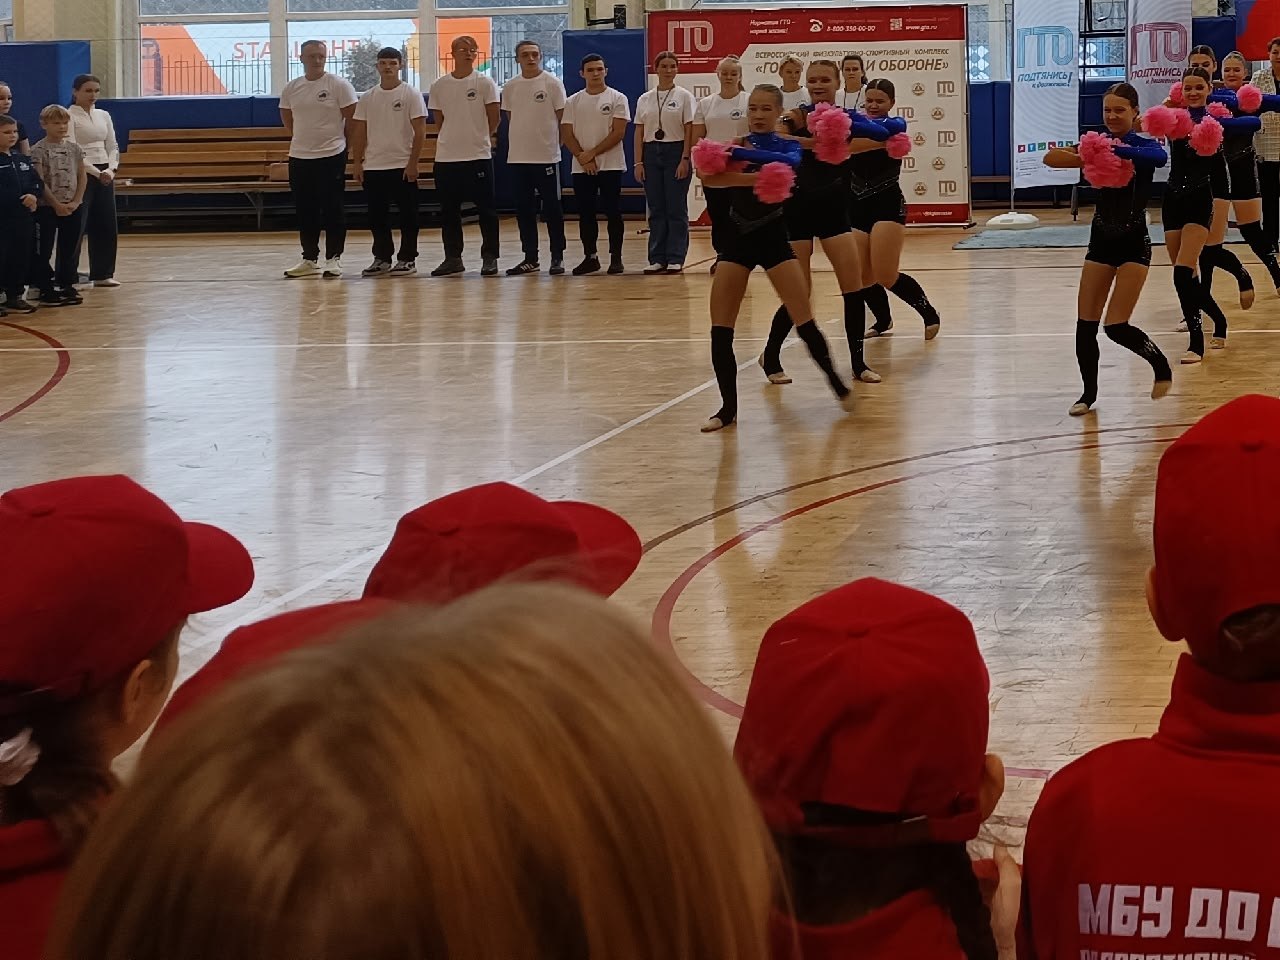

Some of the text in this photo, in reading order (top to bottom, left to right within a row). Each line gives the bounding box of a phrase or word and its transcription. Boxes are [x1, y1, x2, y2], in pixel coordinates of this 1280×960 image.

[667, 21, 713, 52] ГТО
[1130, 21, 1188, 65] ГТО
[1016, 25, 1074, 68] ГТО
[866, 58, 949, 71] И ОБОРОНЕ»
[937, 81, 955, 93] ГТО
[938, 131, 956, 143] ГТО
[903, 157, 915, 168] ТО
[939, 181, 957, 193] ГТО
[1078, 883, 1174, 938] МБУ
[1184, 887, 1260, 941] ДО
